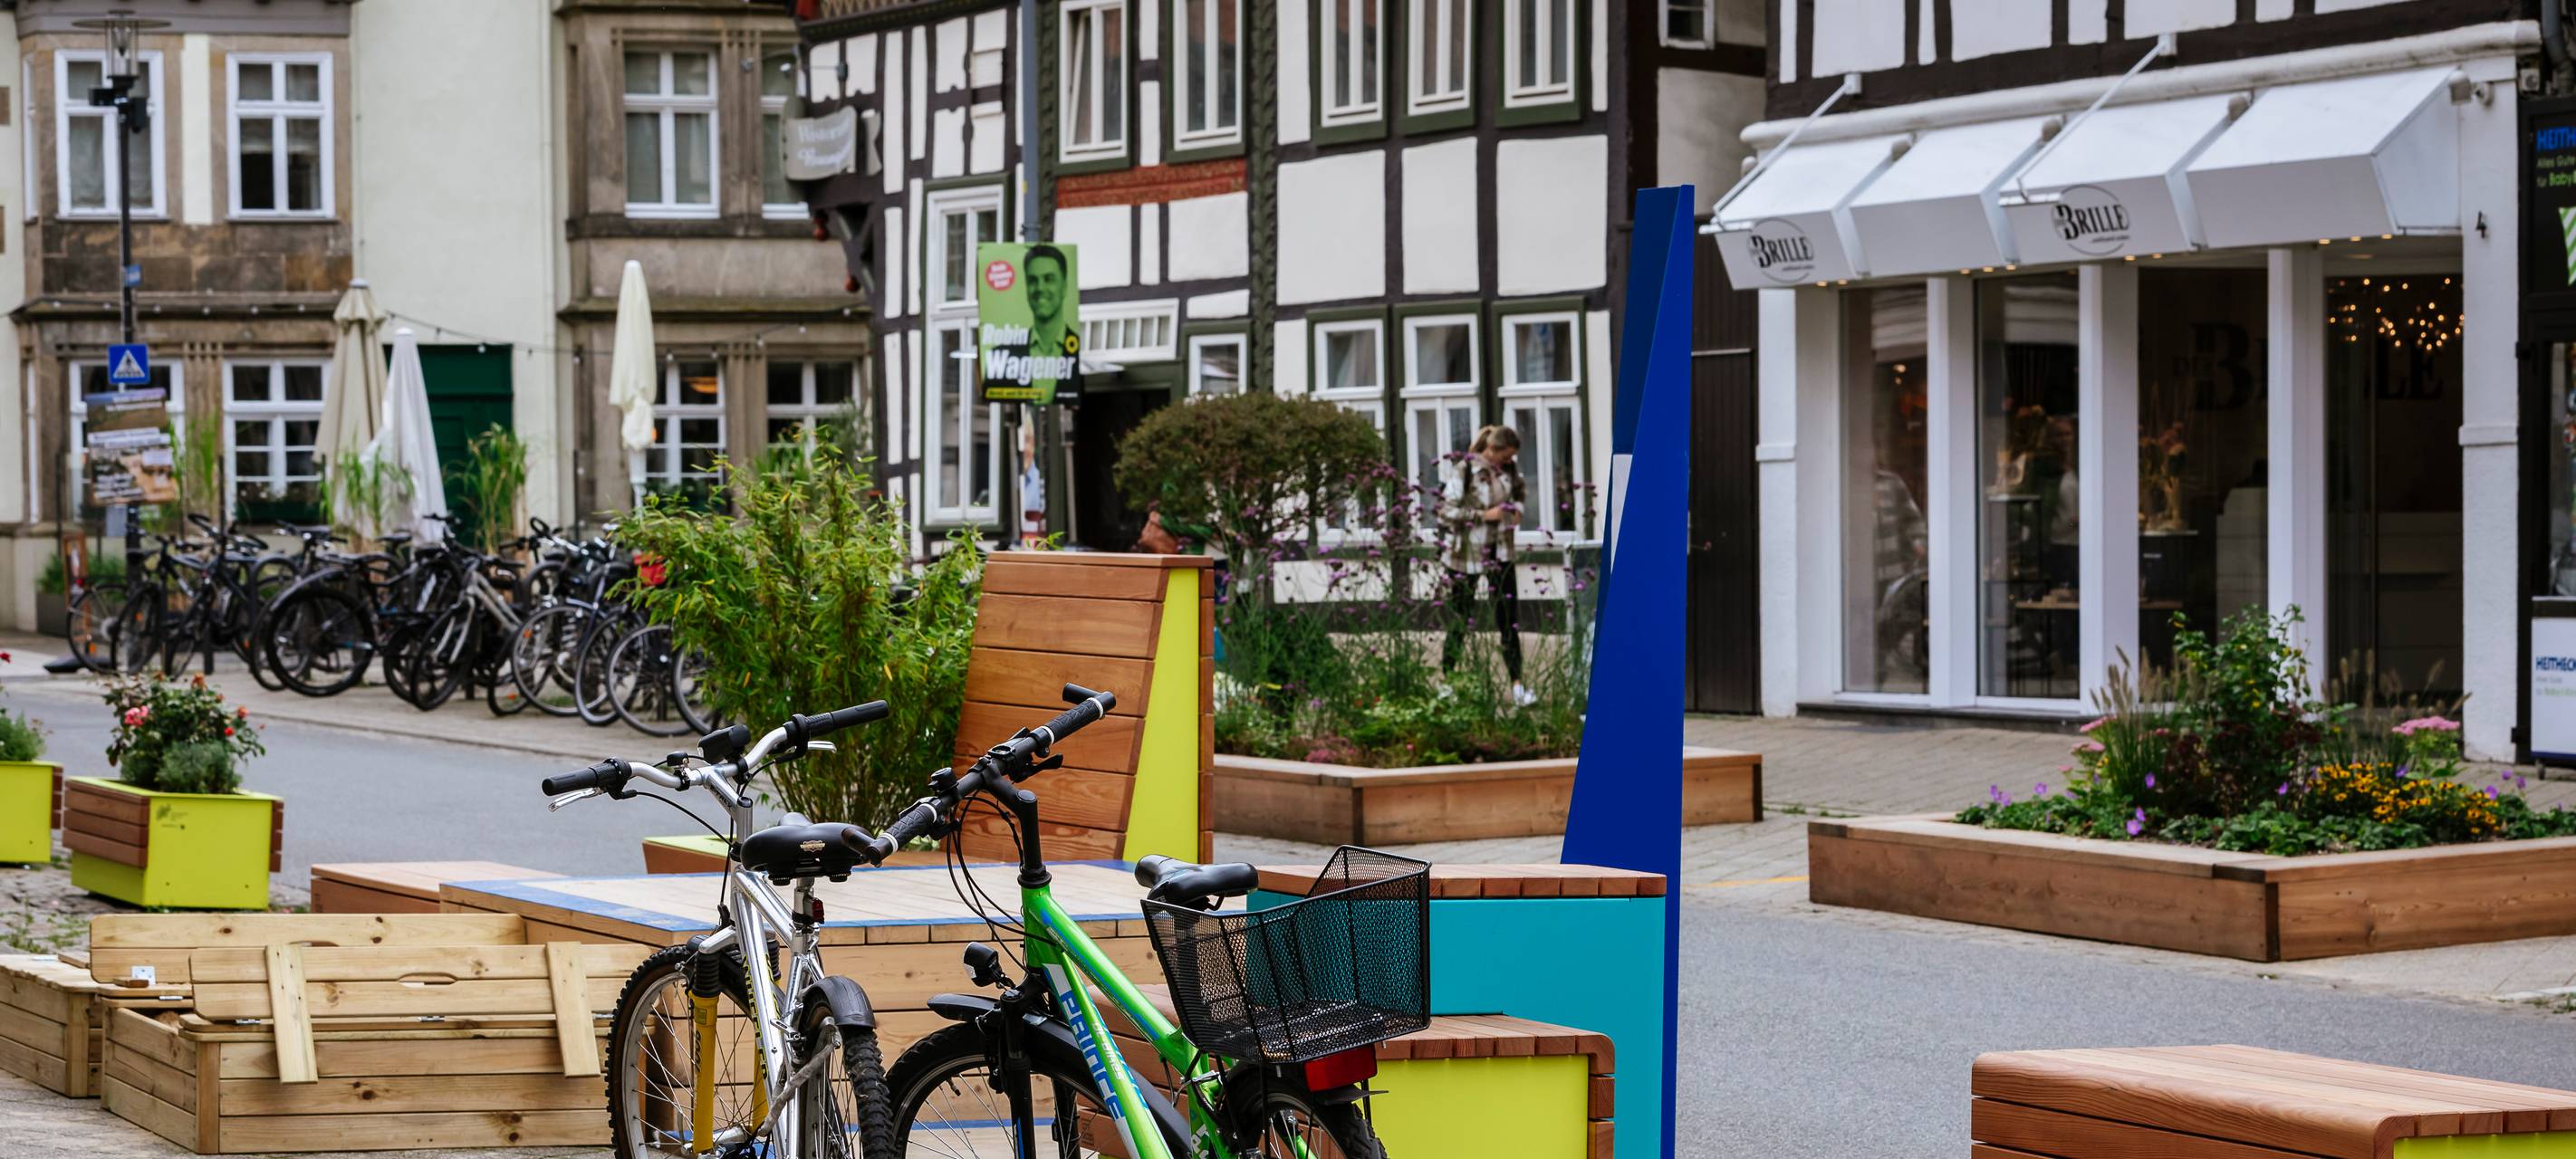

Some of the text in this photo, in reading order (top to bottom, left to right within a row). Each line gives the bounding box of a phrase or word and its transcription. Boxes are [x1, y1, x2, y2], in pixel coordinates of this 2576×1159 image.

[2055, 204, 2129, 240] BRILLE
[2475, 210, 2487, 239] 4
[1750, 235, 1814, 268] BRILLE
[983, 322, 1030, 346] Robin
[985, 349, 1077, 385] Wagener
